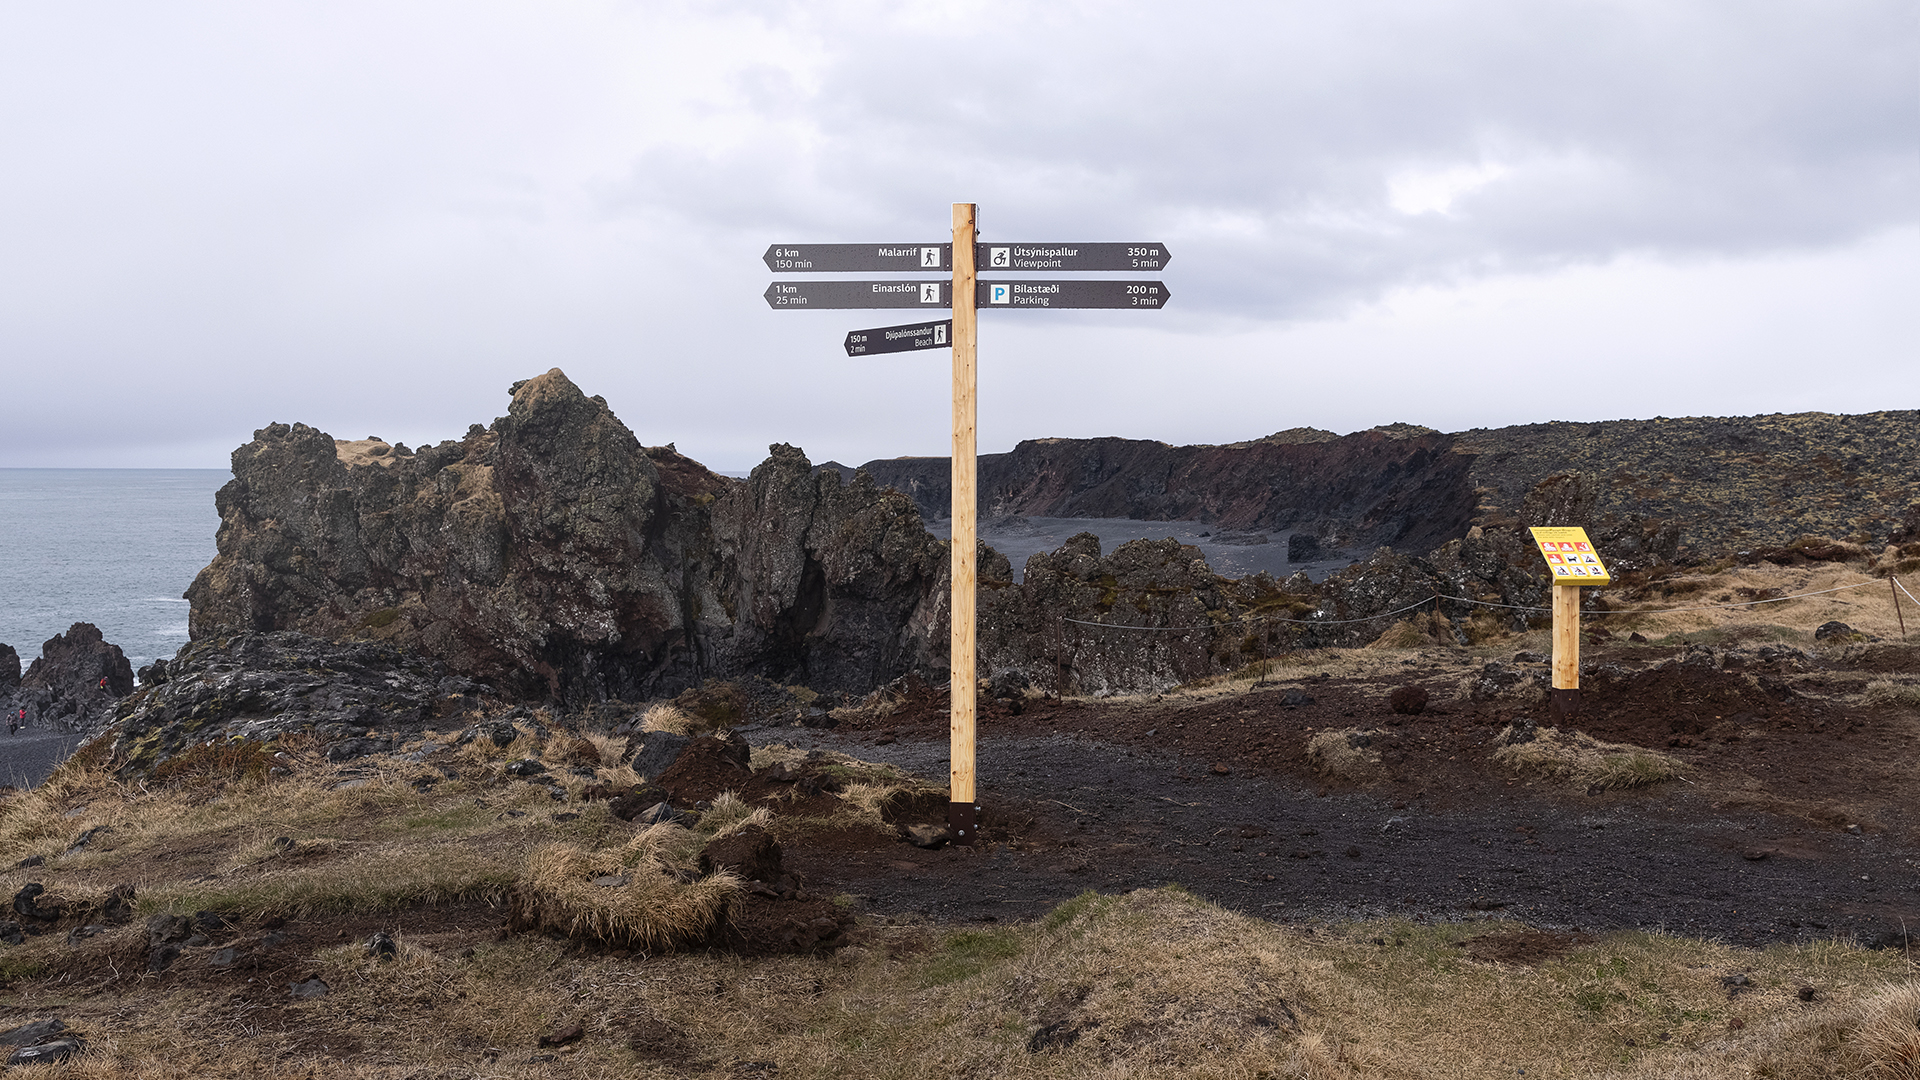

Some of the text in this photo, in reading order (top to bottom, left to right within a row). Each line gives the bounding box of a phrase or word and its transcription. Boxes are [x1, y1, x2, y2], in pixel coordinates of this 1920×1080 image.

[776, 248, 799, 257] 6 km
[878, 248, 917, 256] Malarrif
[1014, 246, 1078, 258] Útsýnispallur
[1128, 248, 1147, 256] 350
[776, 260, 792, 268] 150
[1014, 259, 1062, 269] Viewpoint
[1132, 259, 1138, 268] 5
[783, 285, 797, 293] km
[872, 284, 916, 292] Einarslón
[1014, 285, 1060, 294] Bílastæði
[1126, 286, 1146, 294] 200
[995, 288, 1005, 300] P
[776, 296, 788, 305] 25
[1014, 296, 1049, 306] Parking
[1132, 297, 1138, 306] 3
[850, 335, 861, 344] 150
[915, 338, 932, 346] Beach
[850, 346, 855, 354] 2
